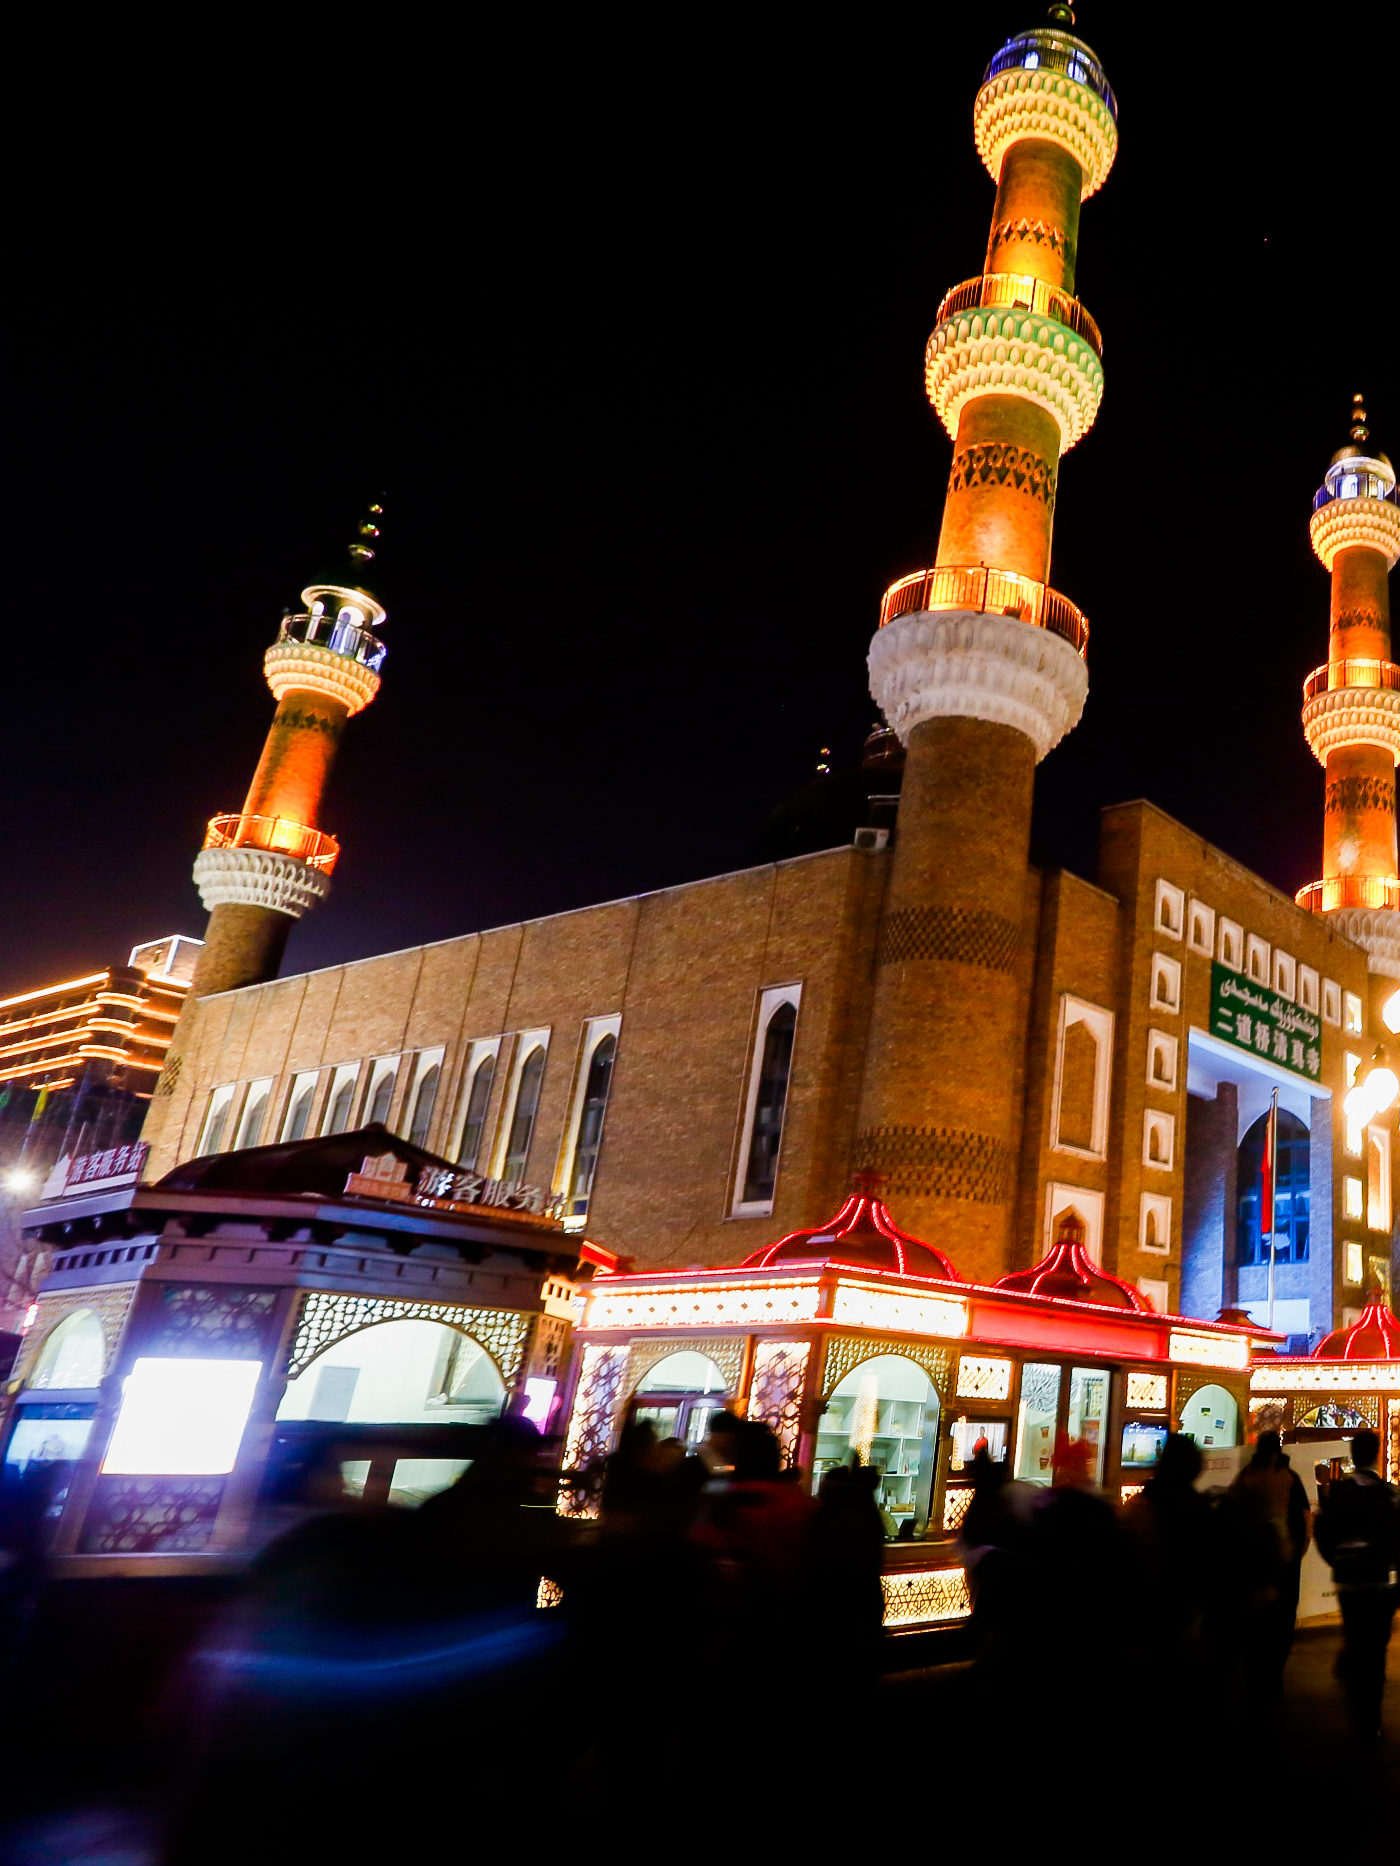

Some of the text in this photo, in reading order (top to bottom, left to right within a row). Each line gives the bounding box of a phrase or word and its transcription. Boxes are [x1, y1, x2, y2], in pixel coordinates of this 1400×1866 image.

[68, 1141, 149, 1184] 游客服务站
